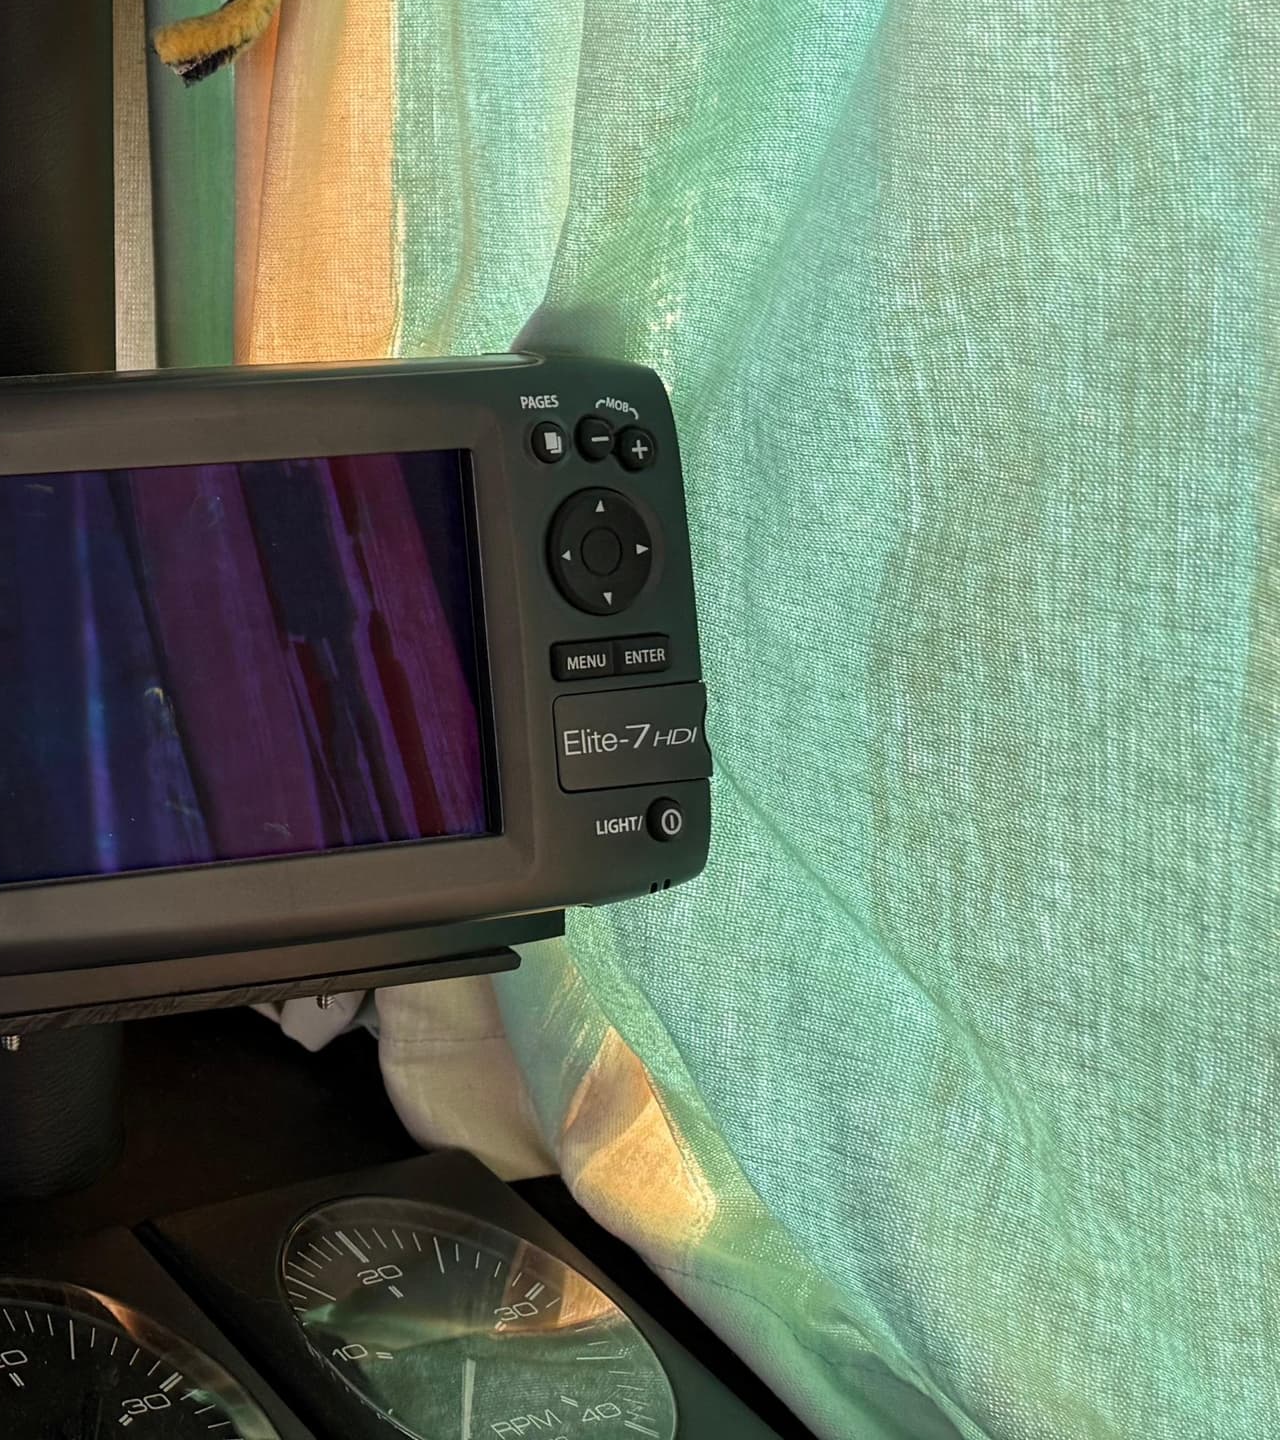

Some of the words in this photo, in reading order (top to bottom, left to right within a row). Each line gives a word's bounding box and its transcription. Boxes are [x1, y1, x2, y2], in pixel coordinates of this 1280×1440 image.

[520, 394, 560, 410] PAGES
[605, 396, 629, 413] MOB
[566, 653, 607, 671] MENU
[624, 648, 666, 665] ENTER
[563, 723, 651, 757] Elite-7
[652, 726, 698, 748] HDI
[356, 1263, 404, 1286] 20
[493, 1300, 539, 1324] 30
[331, 1342, 369, 1362] 10
[120, 1392, 173, 1416] 30
[580, 1401, 622, 1423] 40
[490, 1407, 562, 1440] RPM
